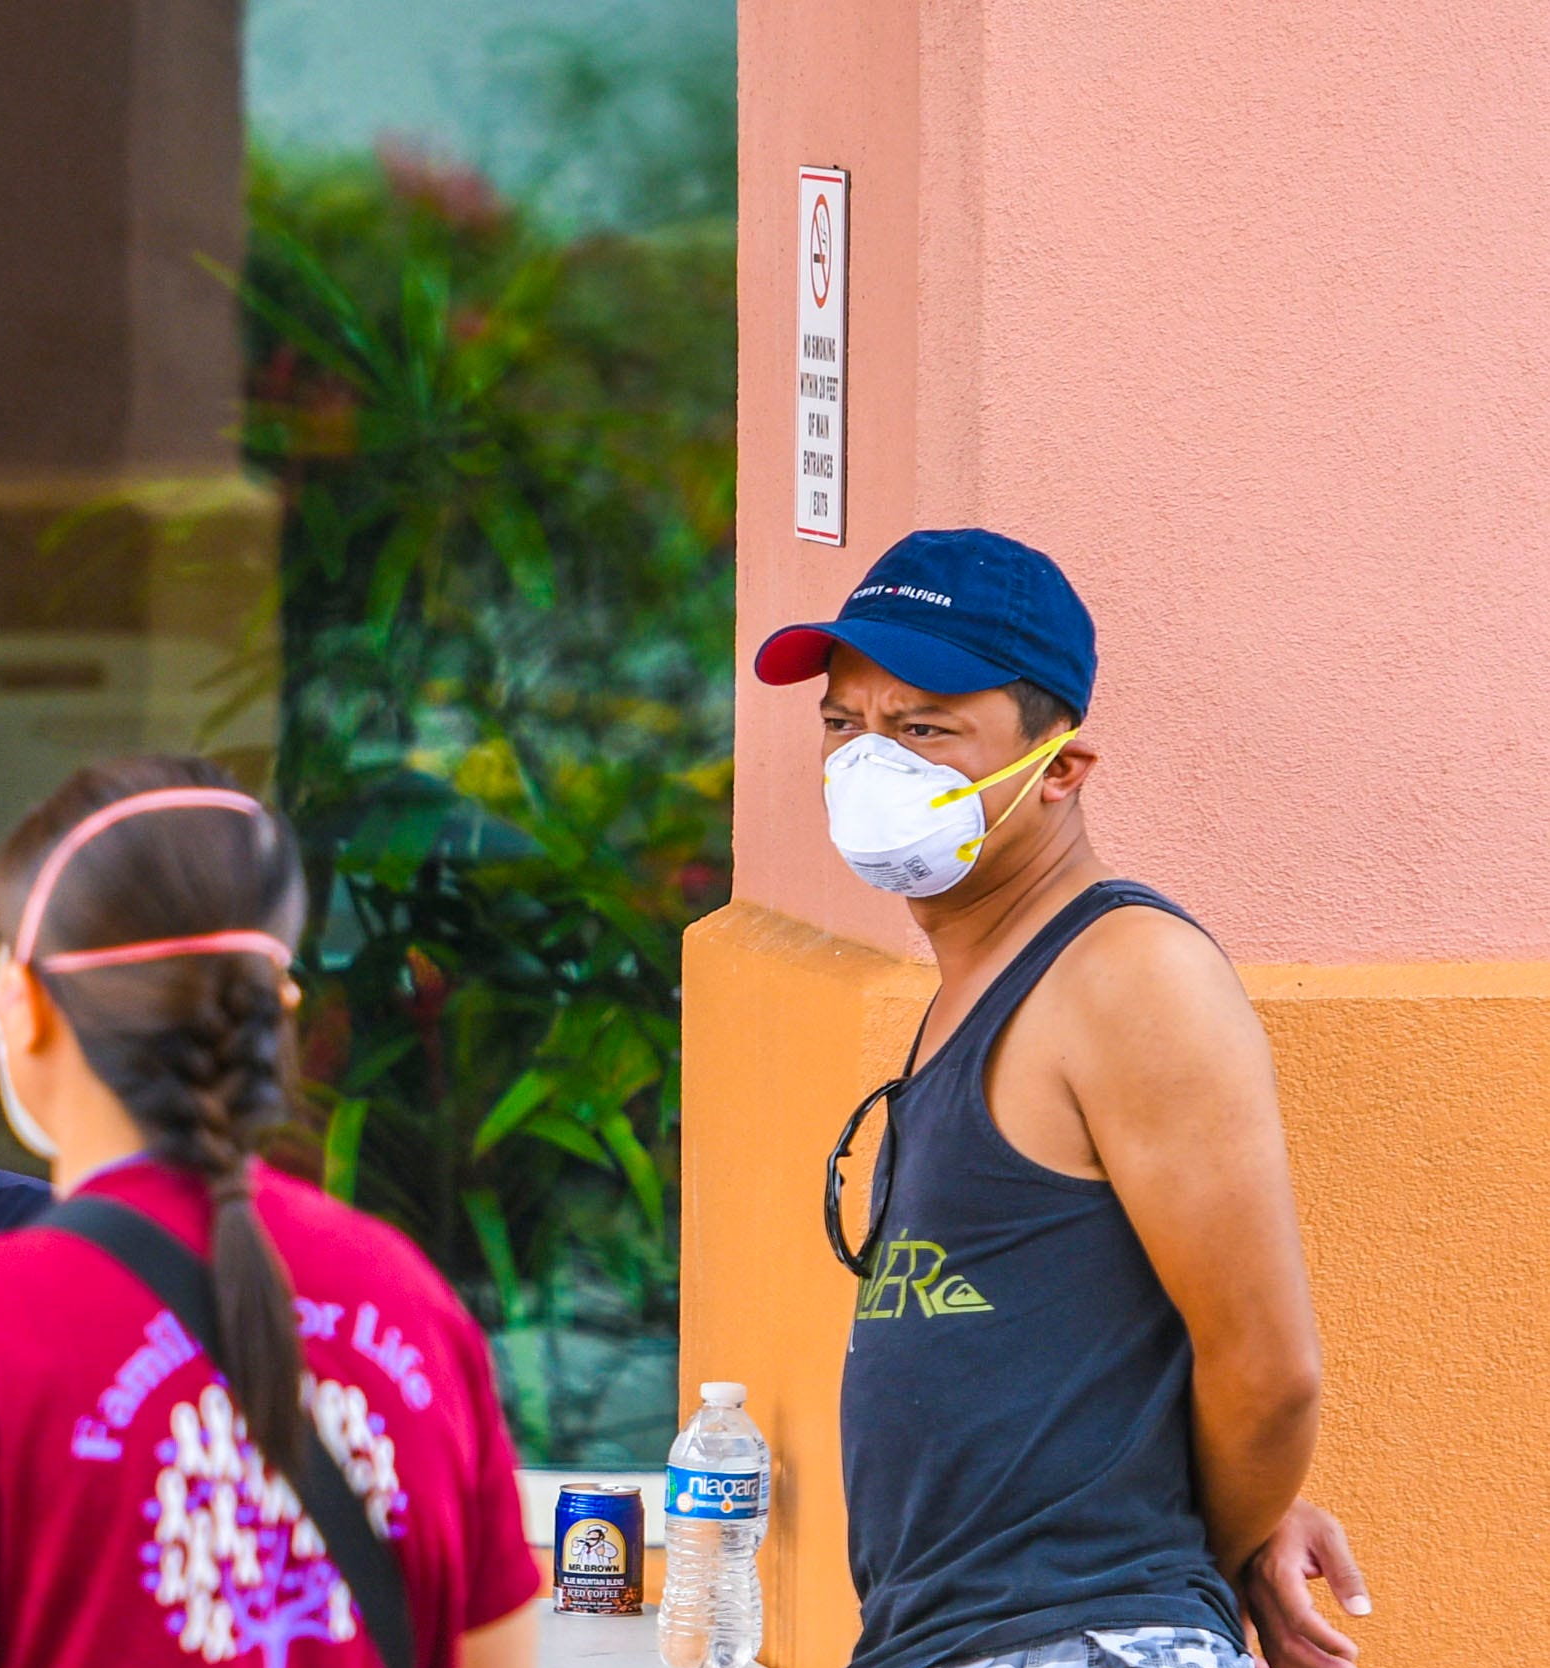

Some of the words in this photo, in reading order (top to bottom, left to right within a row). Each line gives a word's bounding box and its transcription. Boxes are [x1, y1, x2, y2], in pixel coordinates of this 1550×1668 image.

[804, 334, 811, 359] NO
[812, 335, 836, 362] SMOKING
[800, 372, 818, 399] WITHIN
[826, 376, 838, 402] FEET
[808, 412, 815, 437] OF
[816, 413, 830, 440] MAIN
[803, 450, 833, 479] ENTRANCES
[897, 585, 952, 608] HILFIGER
[71, 1307, 200, 1462] Famil
[292, 1297, 346, 1341] or
[568, 1588, 586, 1597] ICED
[587, 1589, 620, 1599] COFFEE
[577, 1577, 605, 1586] MOUNTAIN
